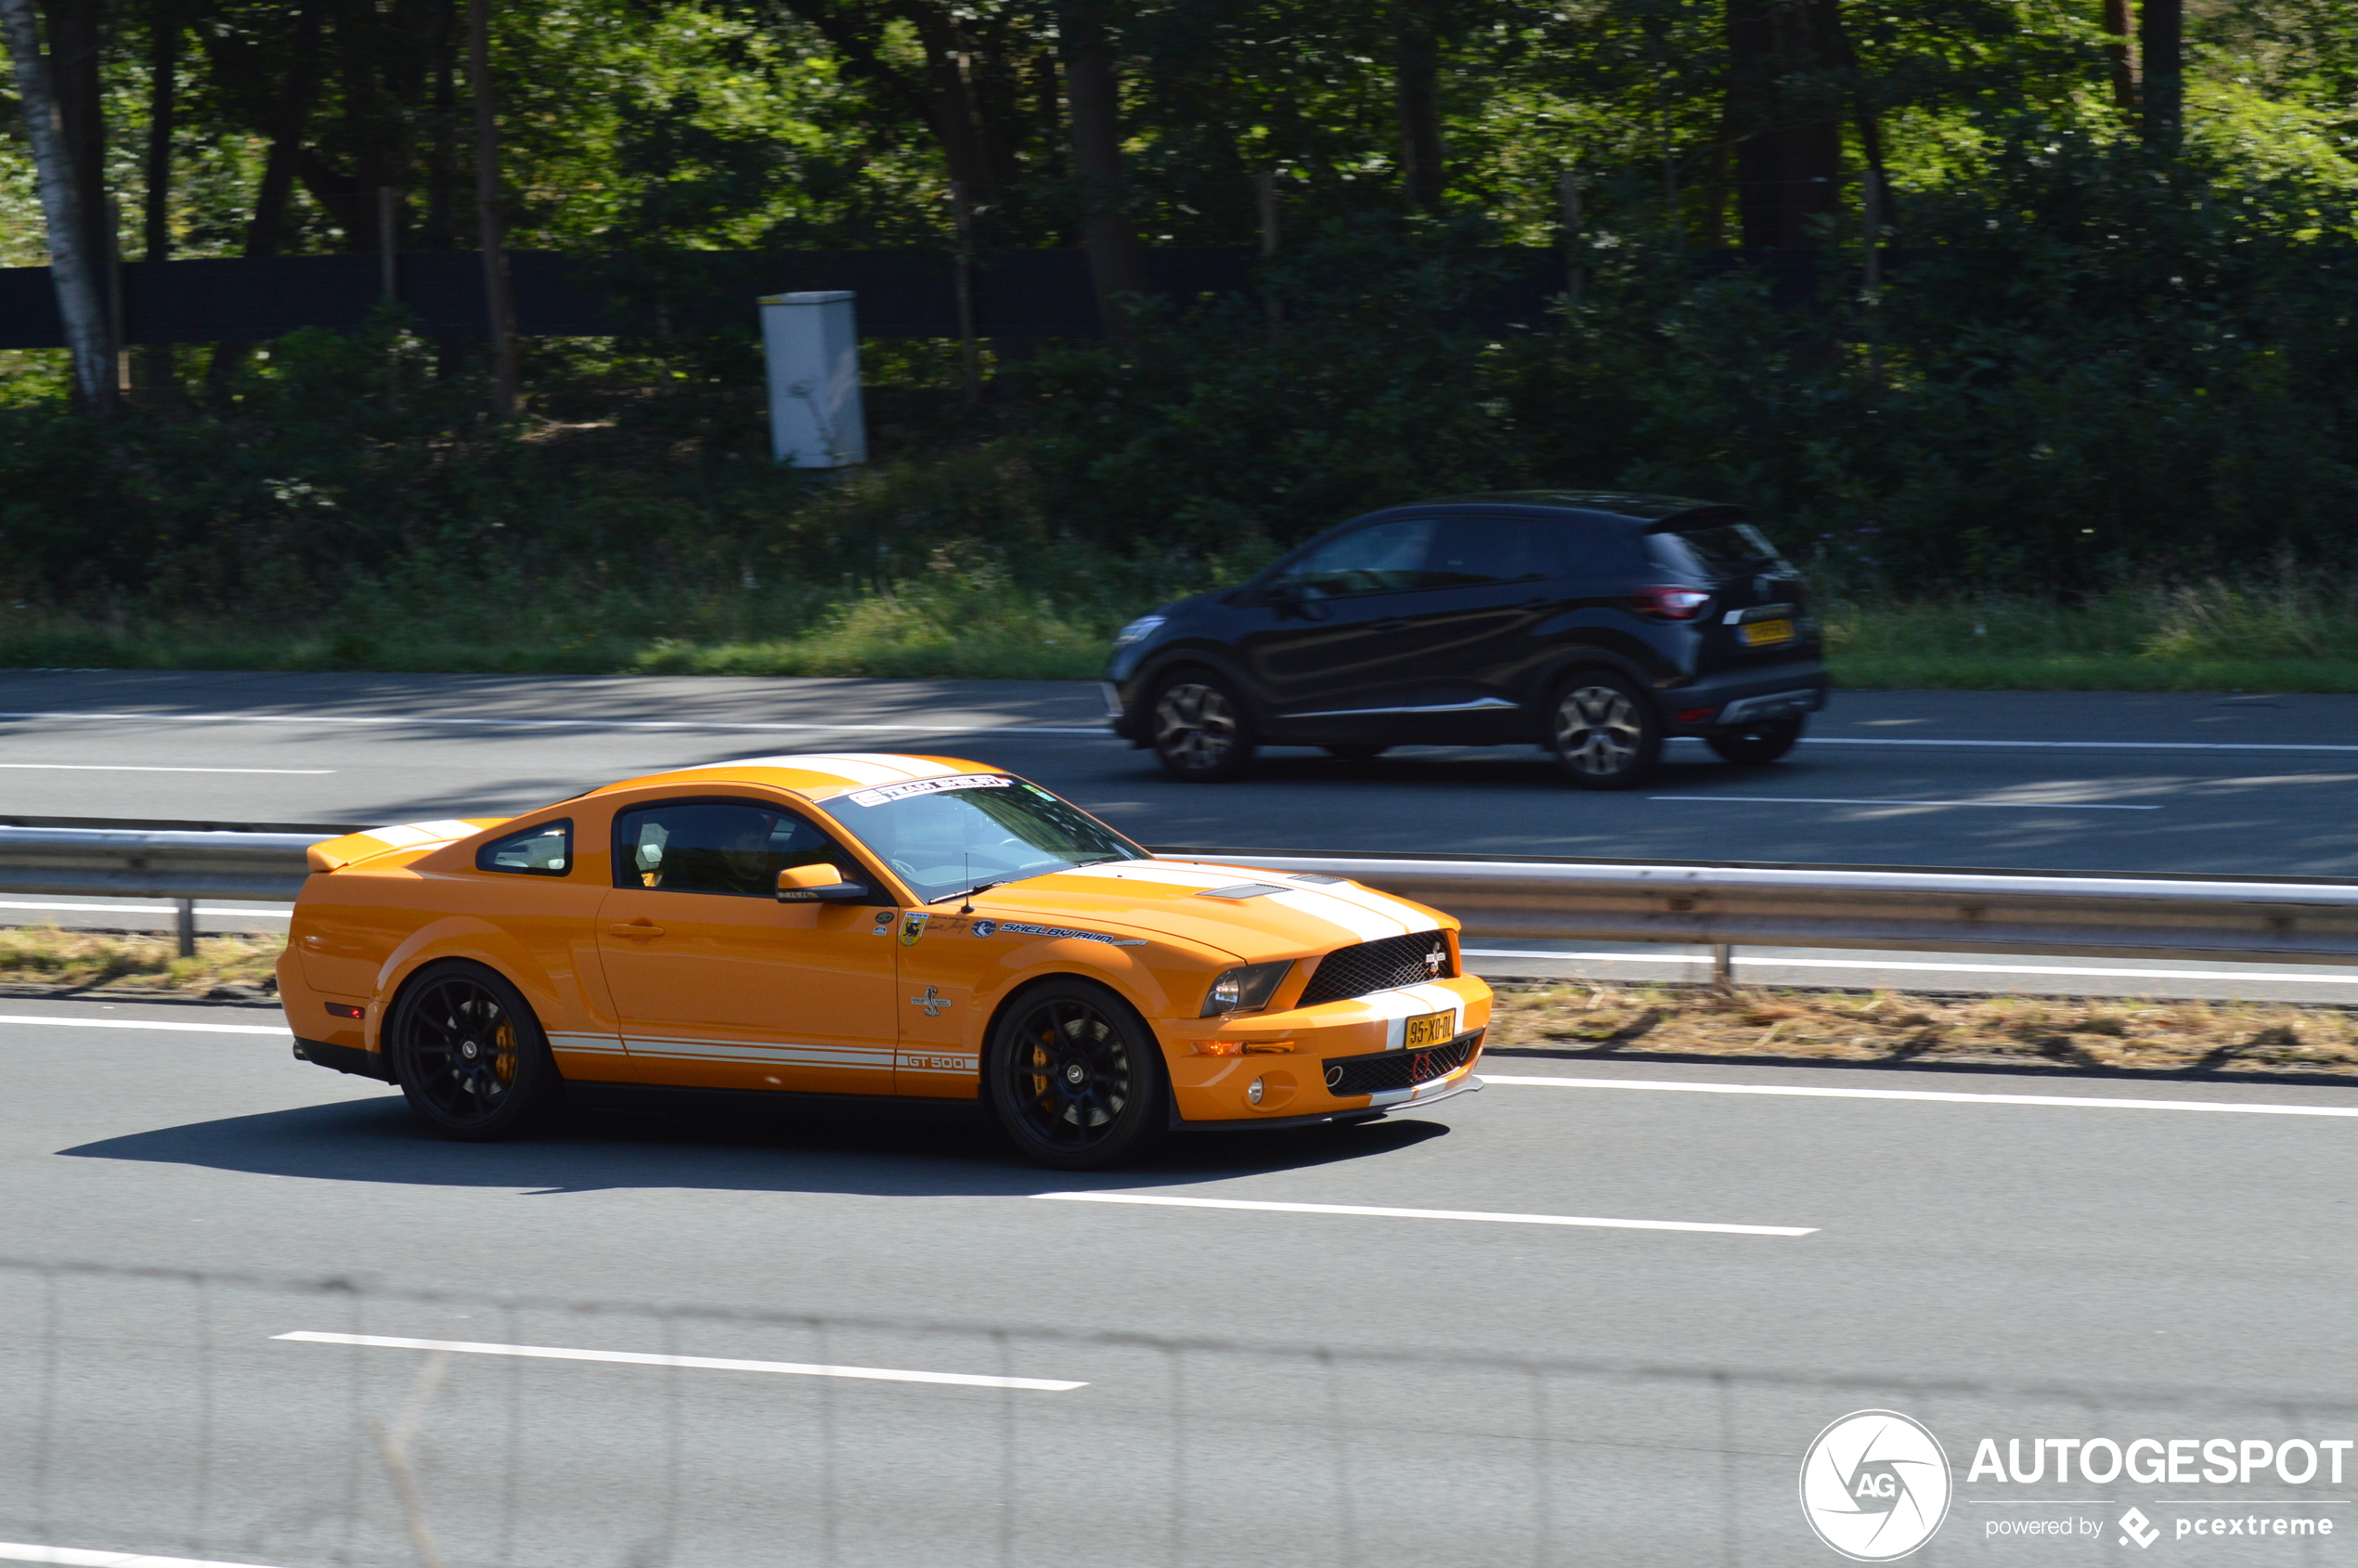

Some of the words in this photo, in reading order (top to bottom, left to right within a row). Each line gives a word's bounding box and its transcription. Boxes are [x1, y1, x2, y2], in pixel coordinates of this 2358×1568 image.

[883, 781, 935, 797] TEAM
[937, 777, 1002, 790] SHELBY
[1001, 922, 1074, 938] SHELBY
[1072, 932, 1114, 944] RUN
[909, 1056, 928, 1067] GT
[931, 1056, 965, 1069] 500
